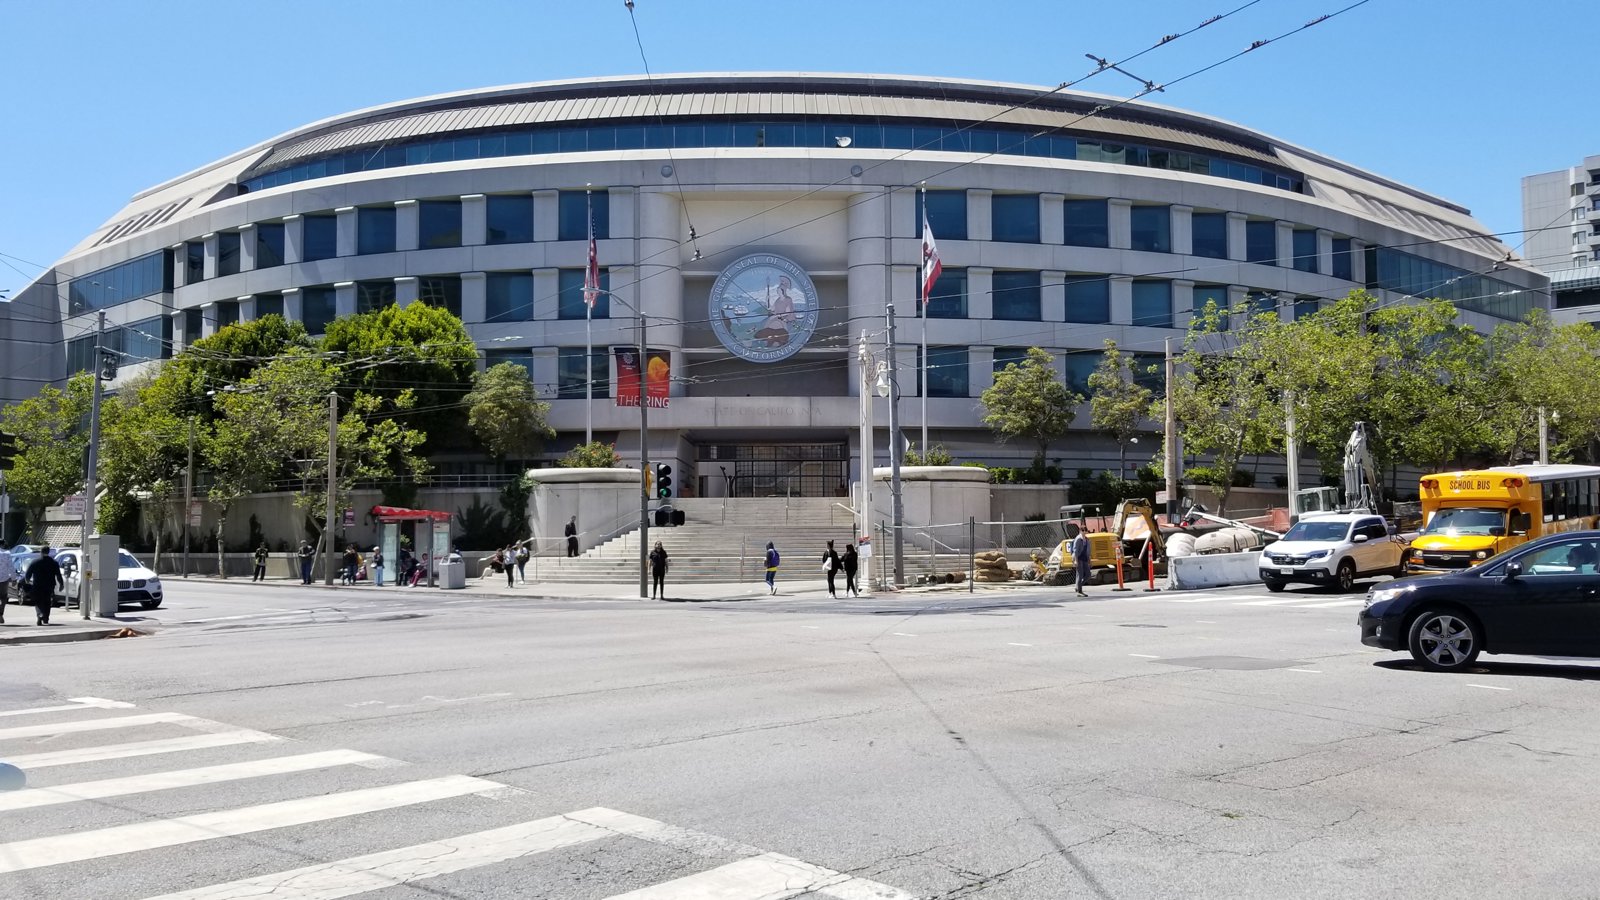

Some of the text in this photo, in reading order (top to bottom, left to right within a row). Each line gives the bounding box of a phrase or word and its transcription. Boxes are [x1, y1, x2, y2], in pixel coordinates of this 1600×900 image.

[735, 257, 759, 270] SEAL
[766, 256, 779, 265] OF
[784, 262, 800, 277] THE
[713, 271, 732, 302] GREAT
[803, 280, 816, 307] STATE
[807, 313, 816, 325] OF
[733, 344, 795, 360] CALIFORNIA
[618, 395, 670, 408] THE RING
[756, 407, 823, 416] CALIFONA
[1449, 480, 1491, 490] SCHOOL BUS
